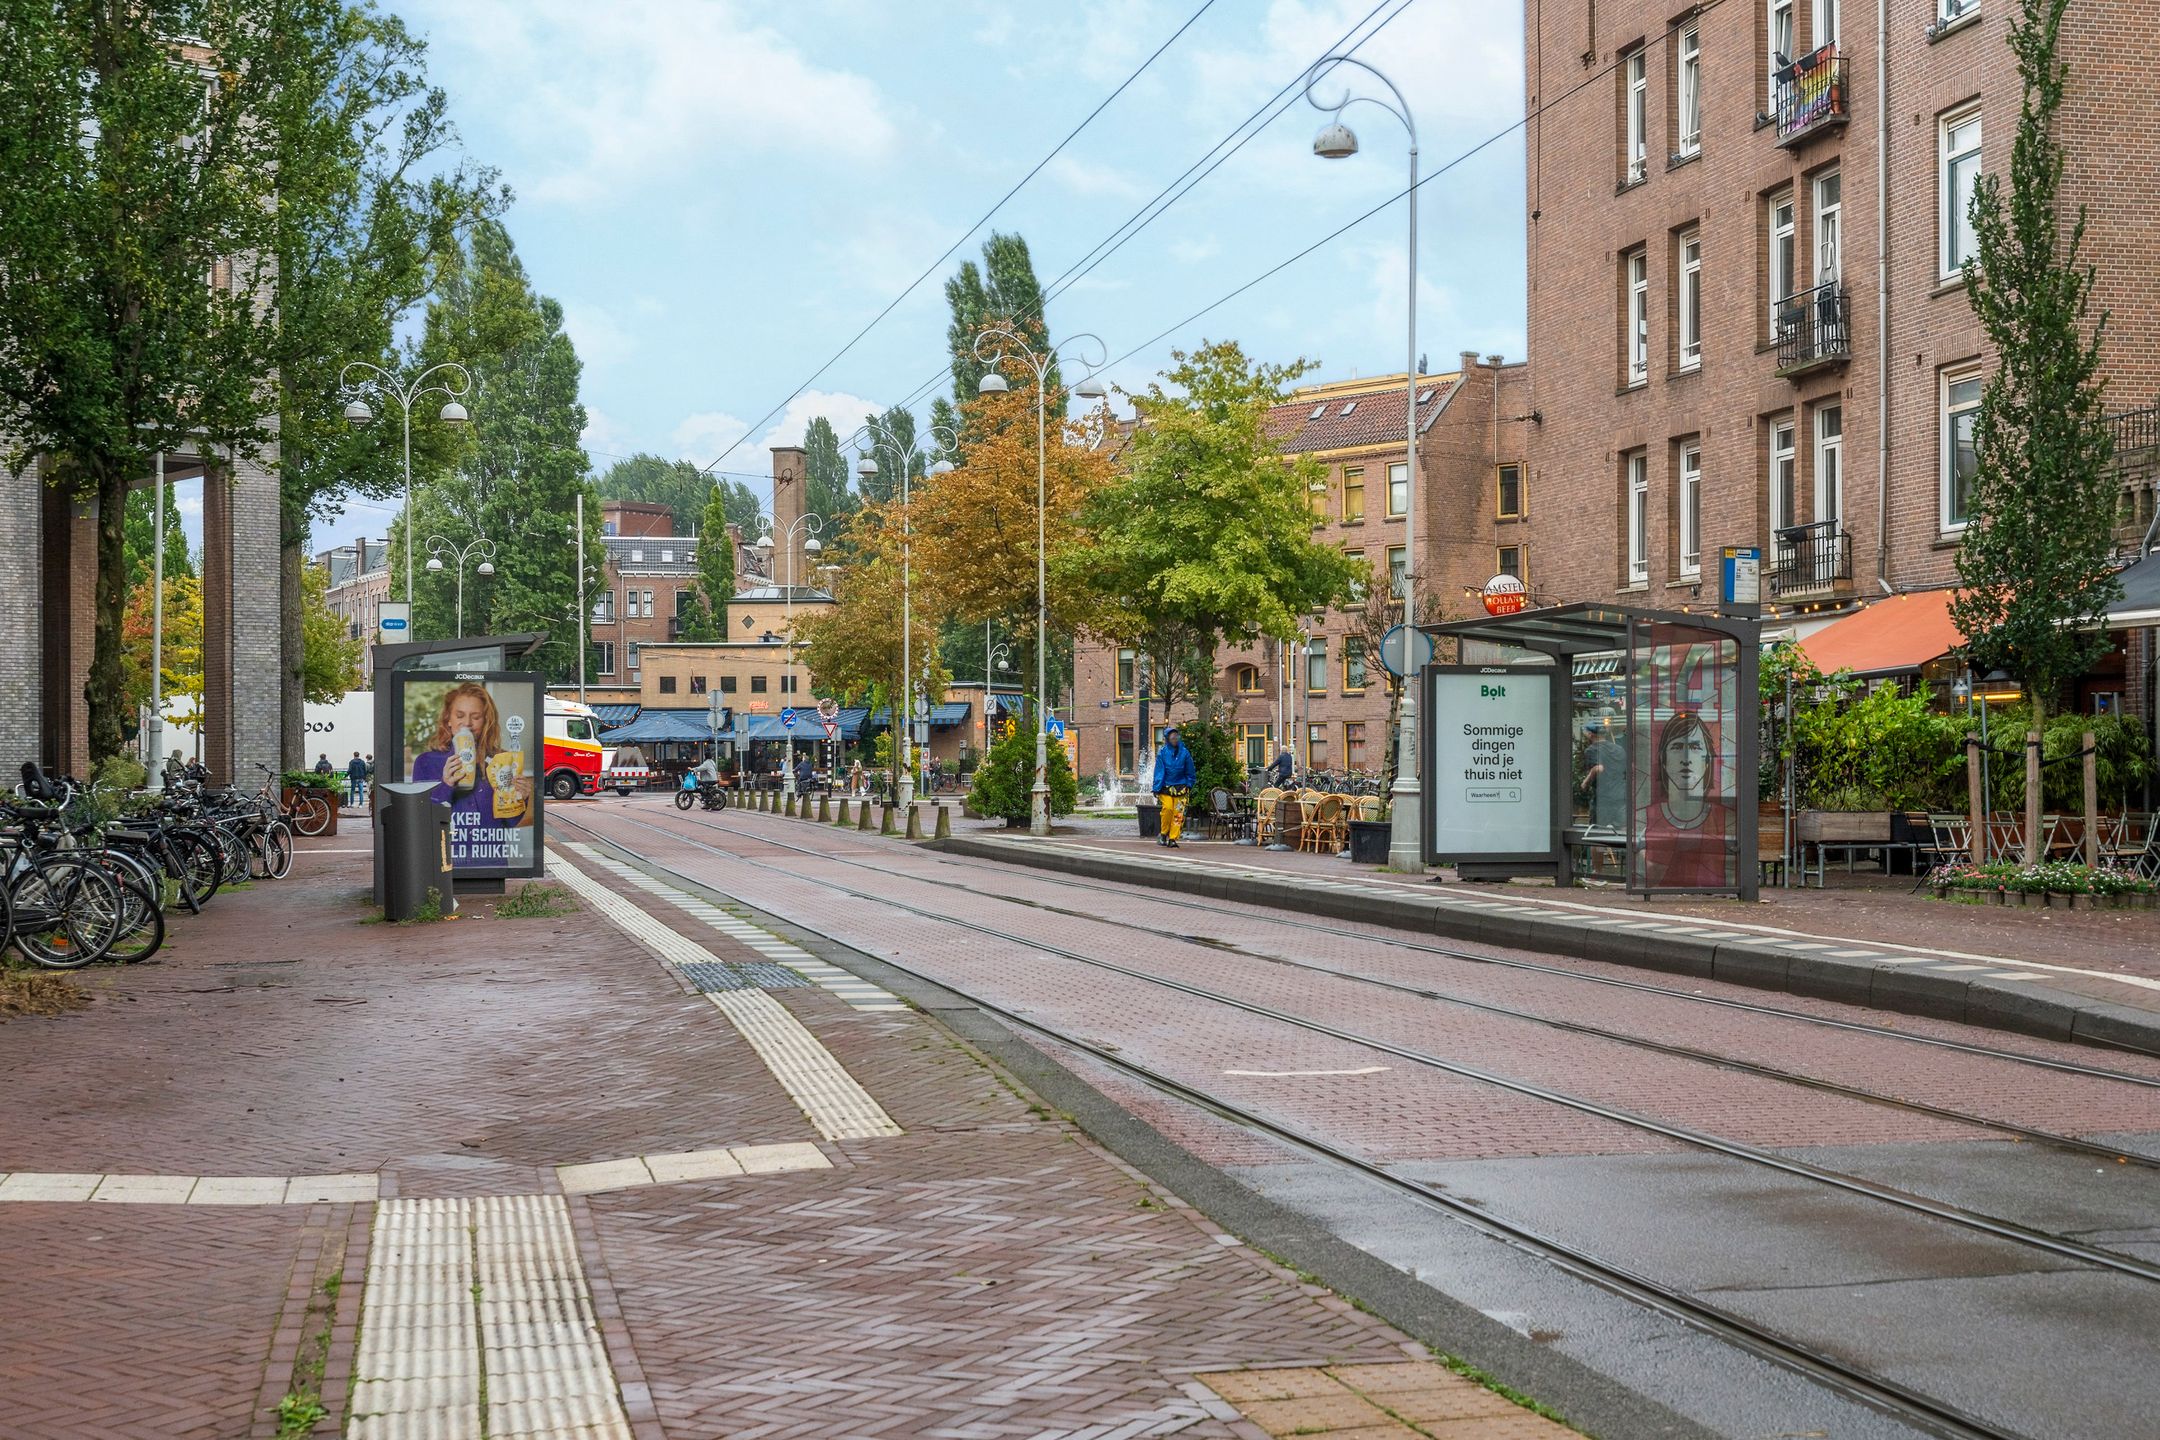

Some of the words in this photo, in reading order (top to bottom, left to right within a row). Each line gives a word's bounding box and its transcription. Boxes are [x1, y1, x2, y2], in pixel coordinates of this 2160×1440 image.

[1485, 583, 1523, 593] AMSTEL
[1496, 605, 1516, 614] BEER
[1480, 685, 1506, 701] Bolt
[1463, 723, 1524, 738] Sommige
[1471, 738, 1515, 753] dingen
[1472, 753, 1500, 765] vind
[1501, 753, 1514, 768] je
[1464, 768, 1496, 780] thuis
[1498, 768, 1523, 780] niet
[472, 828, 521, 842] SCHONE
[471, 844, 524, 858] RUIKEN.
